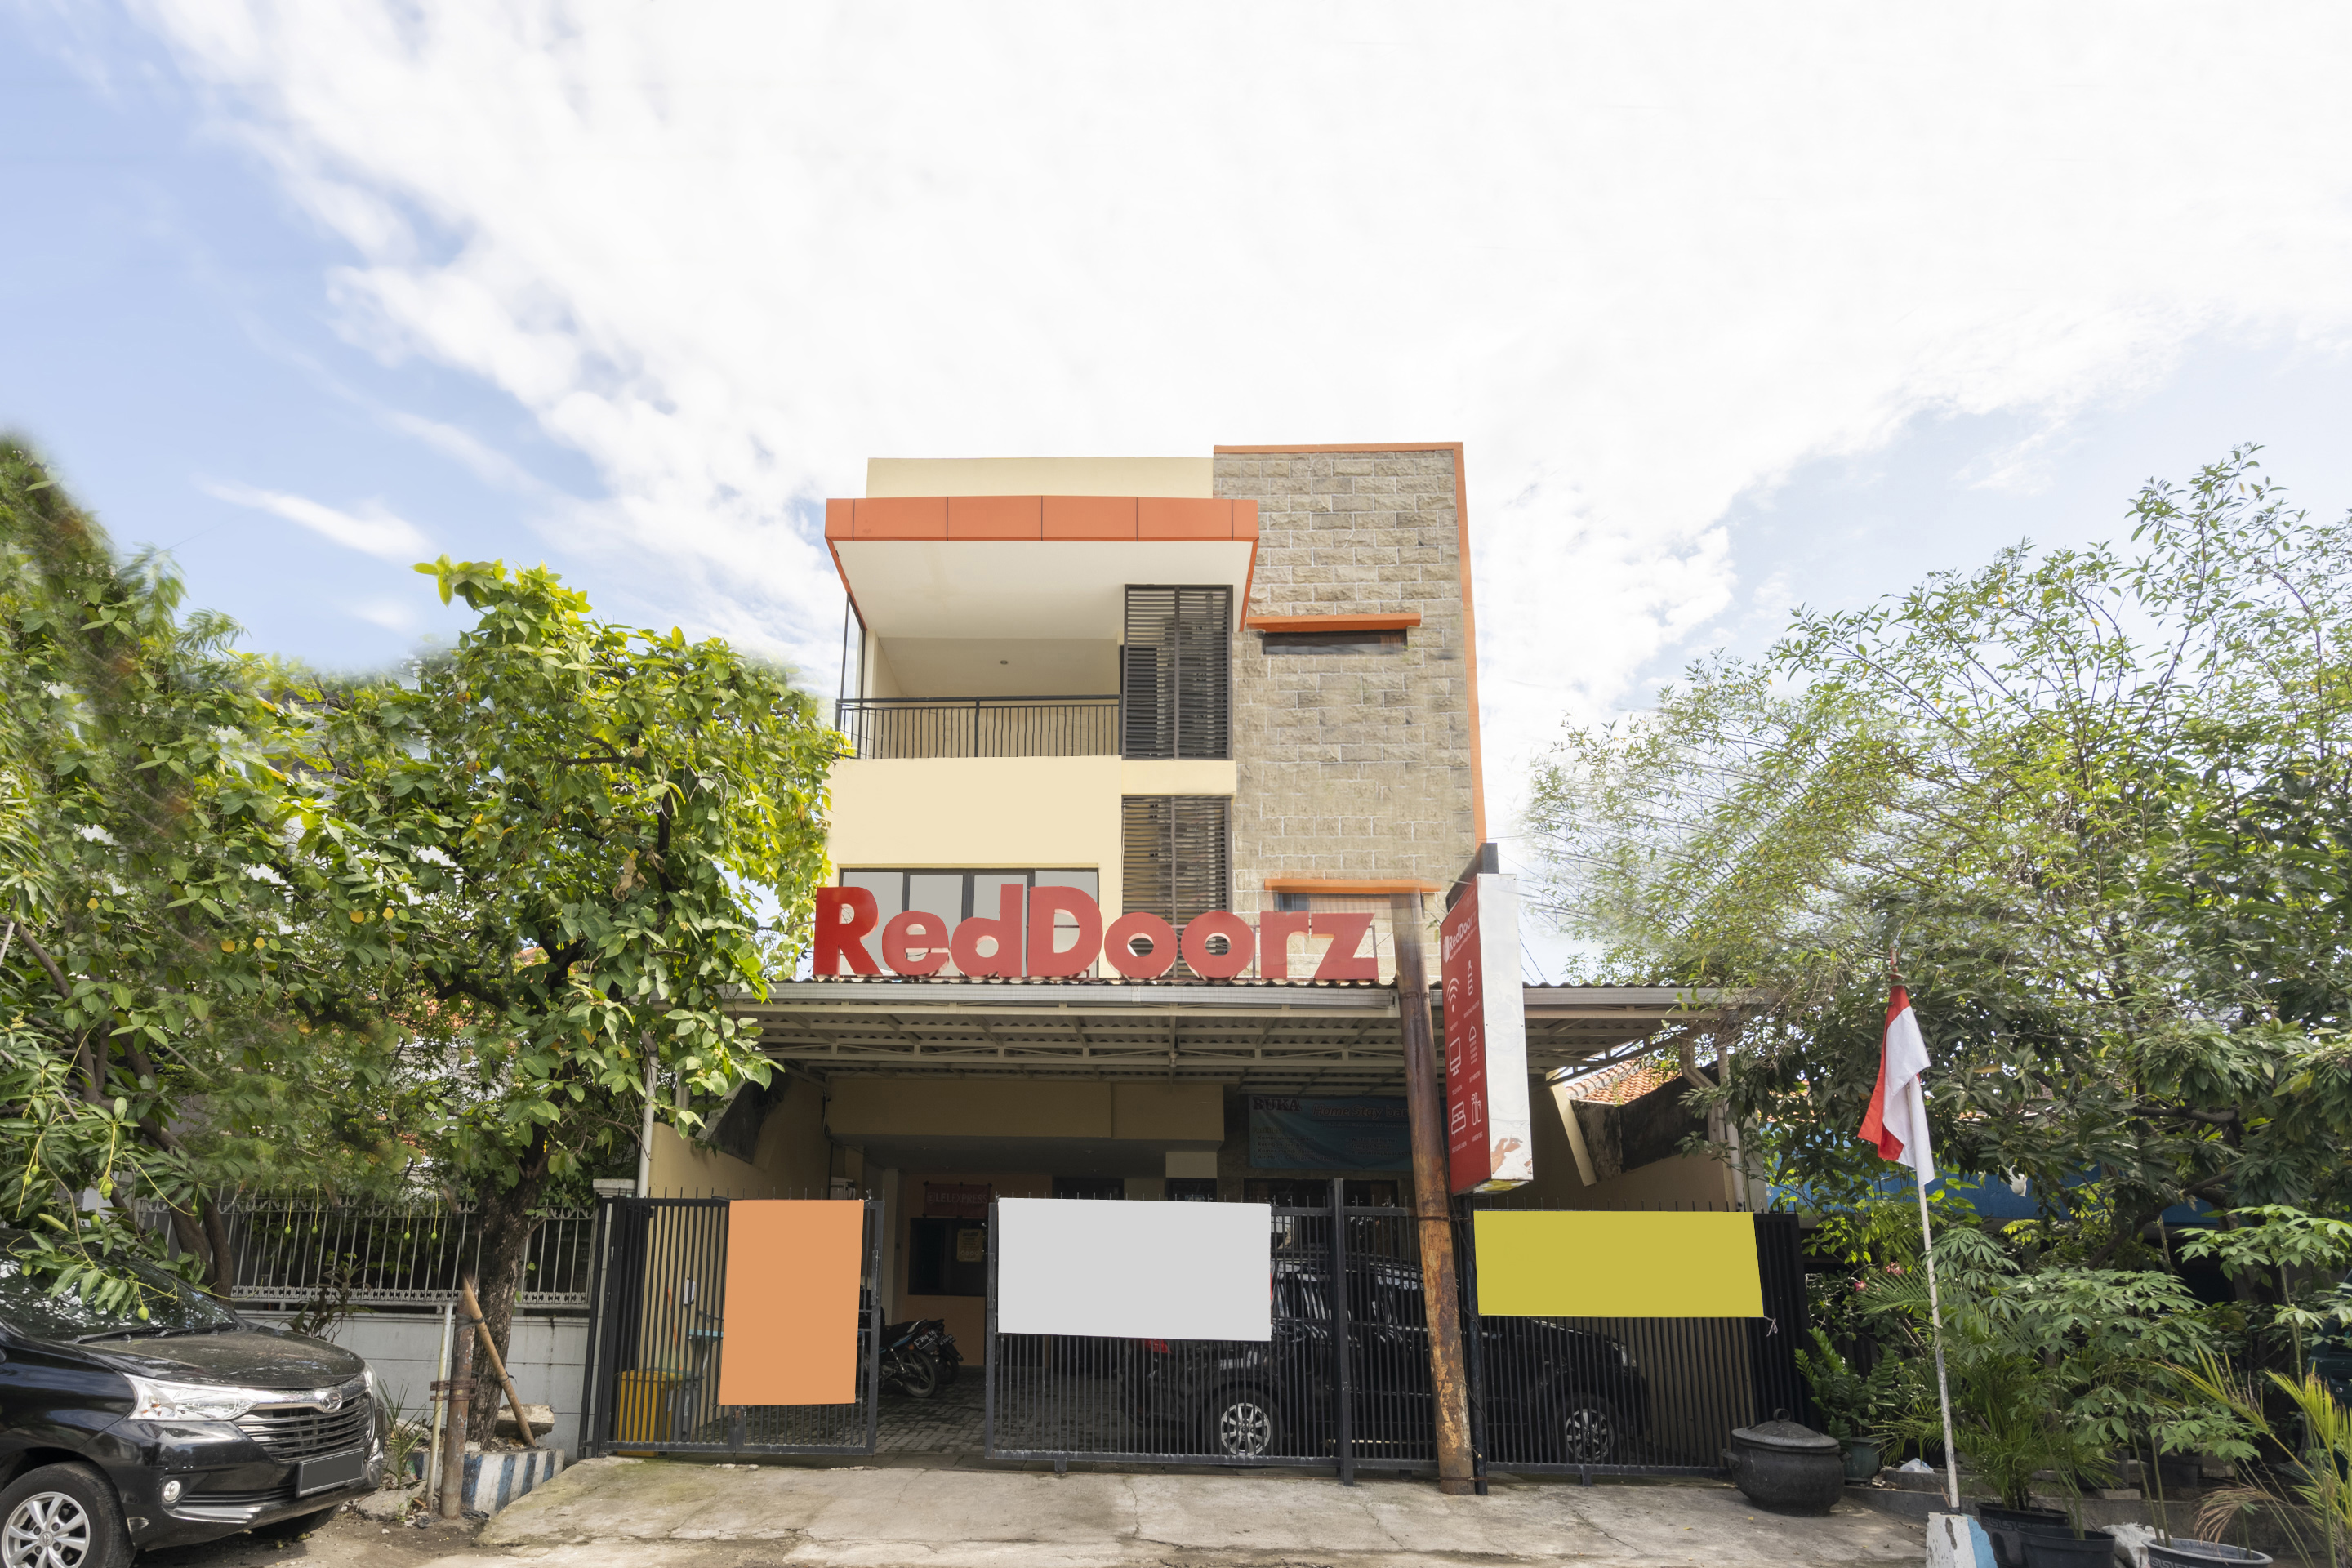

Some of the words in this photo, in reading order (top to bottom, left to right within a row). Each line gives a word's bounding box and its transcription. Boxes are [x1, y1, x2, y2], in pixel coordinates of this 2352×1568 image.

[814, 884, 1380, 979] RedDoorz
[1252, 1096, 1303, 1111] BUKA
[1312, 1104, 1350, 1117] Home
[1352, 1104, 1383, 1120] Stay
[1386, 1104, 1409, 1118] bar
